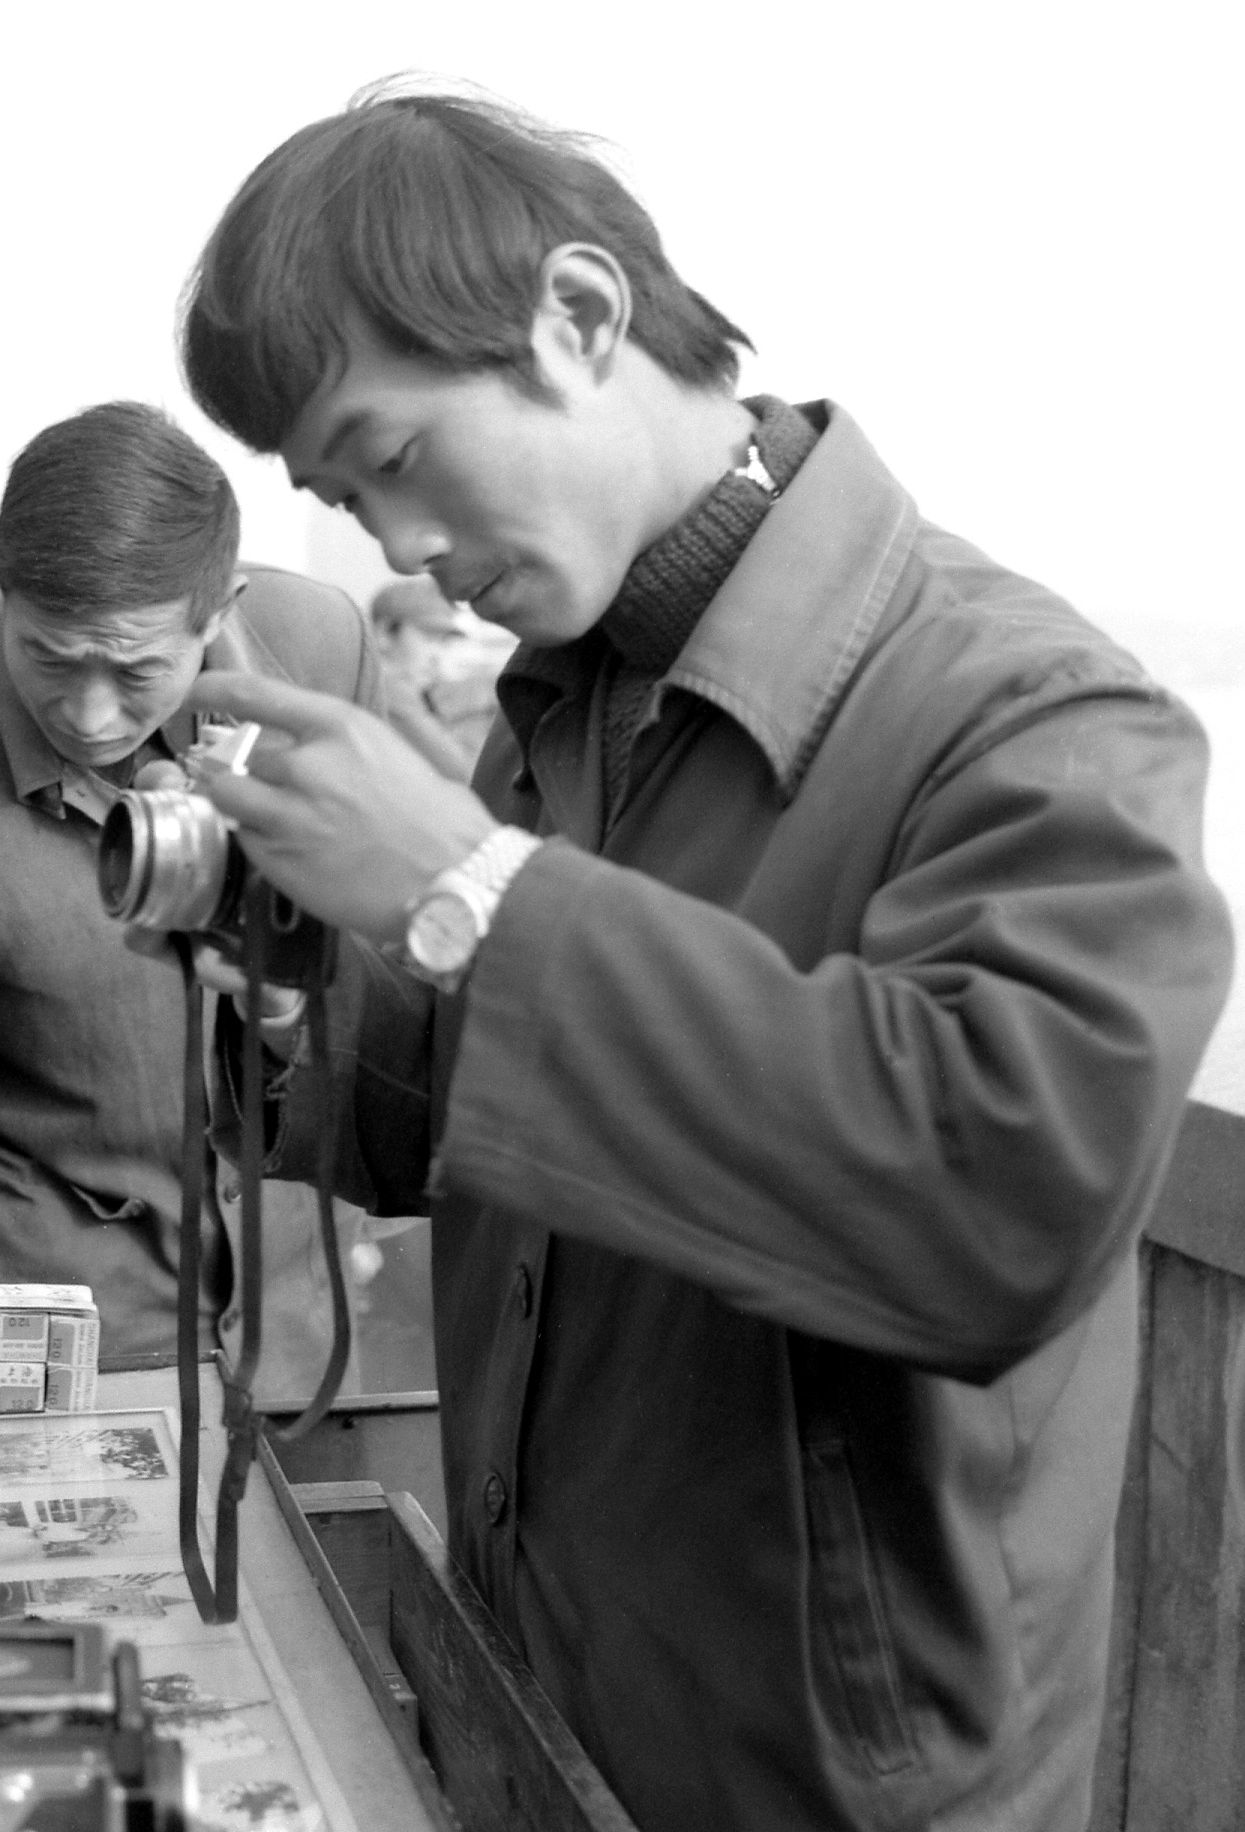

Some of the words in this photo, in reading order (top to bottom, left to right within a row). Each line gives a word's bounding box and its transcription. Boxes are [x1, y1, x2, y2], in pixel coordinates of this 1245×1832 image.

[9, 1317, 30, 1328] 120
[53, 1338, 62, 1359] 120
[49, 1384, 59, 1406] 120
